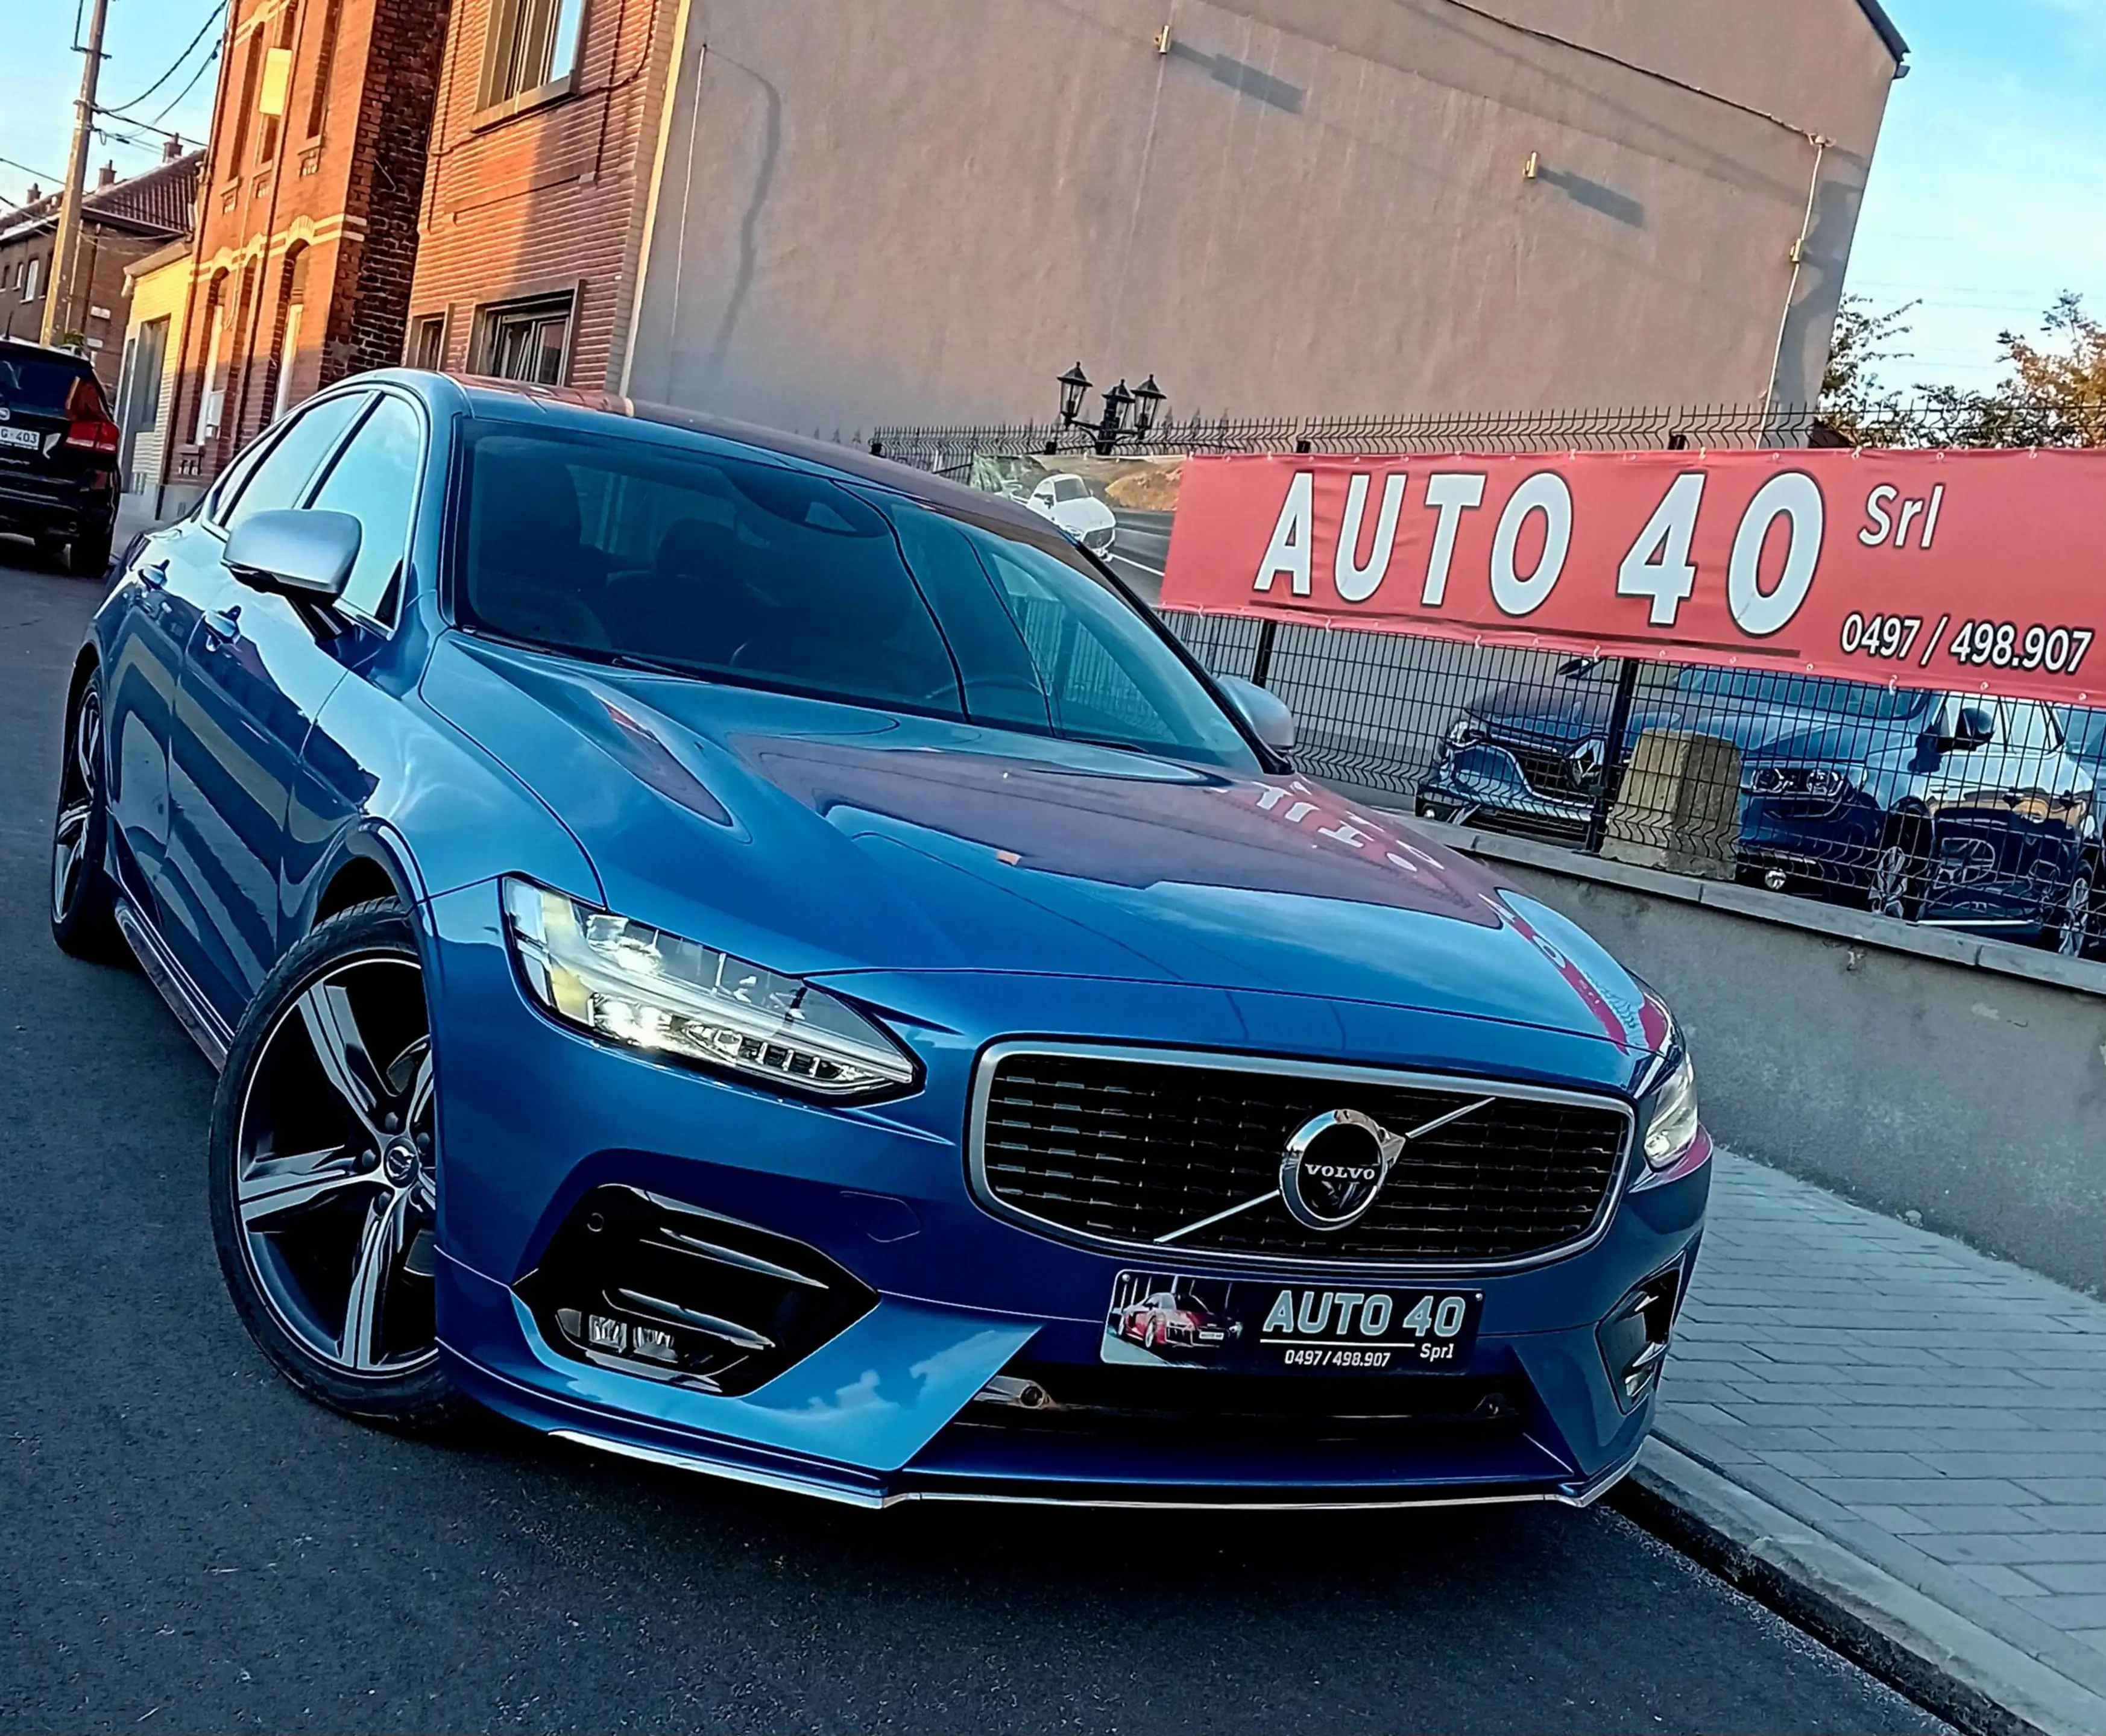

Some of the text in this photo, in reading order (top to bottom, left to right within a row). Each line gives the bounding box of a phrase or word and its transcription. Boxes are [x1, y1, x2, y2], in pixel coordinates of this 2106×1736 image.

[1857, 483, 1944, 549] Srl
[1253, 471, 1826, 638] AUTO 40
[1841, 611, 1923, 659] 0497
[1949, 618, 2094, 674] 498.907
[1305, 1163, 1375, 1180] VOLVO
[1263, 1290, 1466, 1337] AUTO 40
[1420, 1343, 1454, 1362] Sprl
